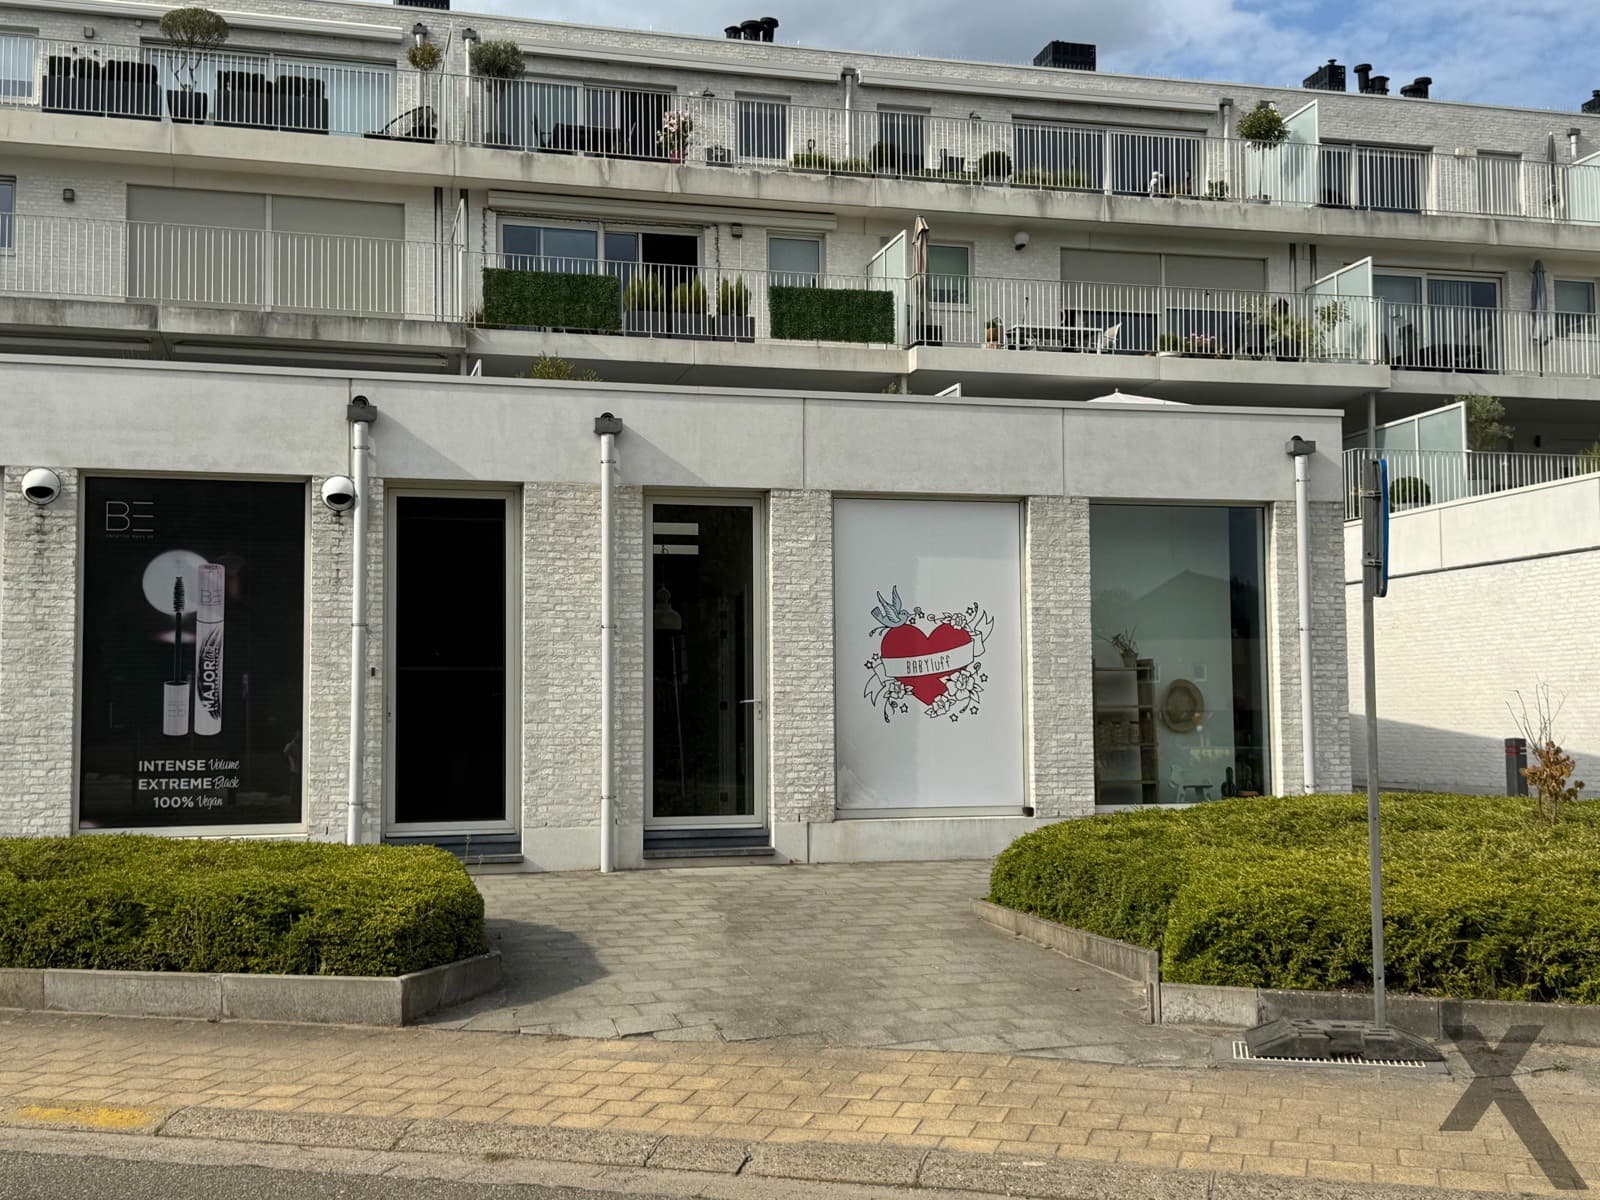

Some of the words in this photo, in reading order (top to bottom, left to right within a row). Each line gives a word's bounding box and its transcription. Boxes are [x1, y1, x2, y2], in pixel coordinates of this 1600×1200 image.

[106, 501, 154, 531] BE
[138, 760, 206, 772] INTENSE
[208, 759, 240, 771] Volume
[138, 778, 212, 790] EXTREME
[212, 775, 240, 790] Black
[153, 796, 194, 808] 100%
[196, 795, 223, 810] Vegan
